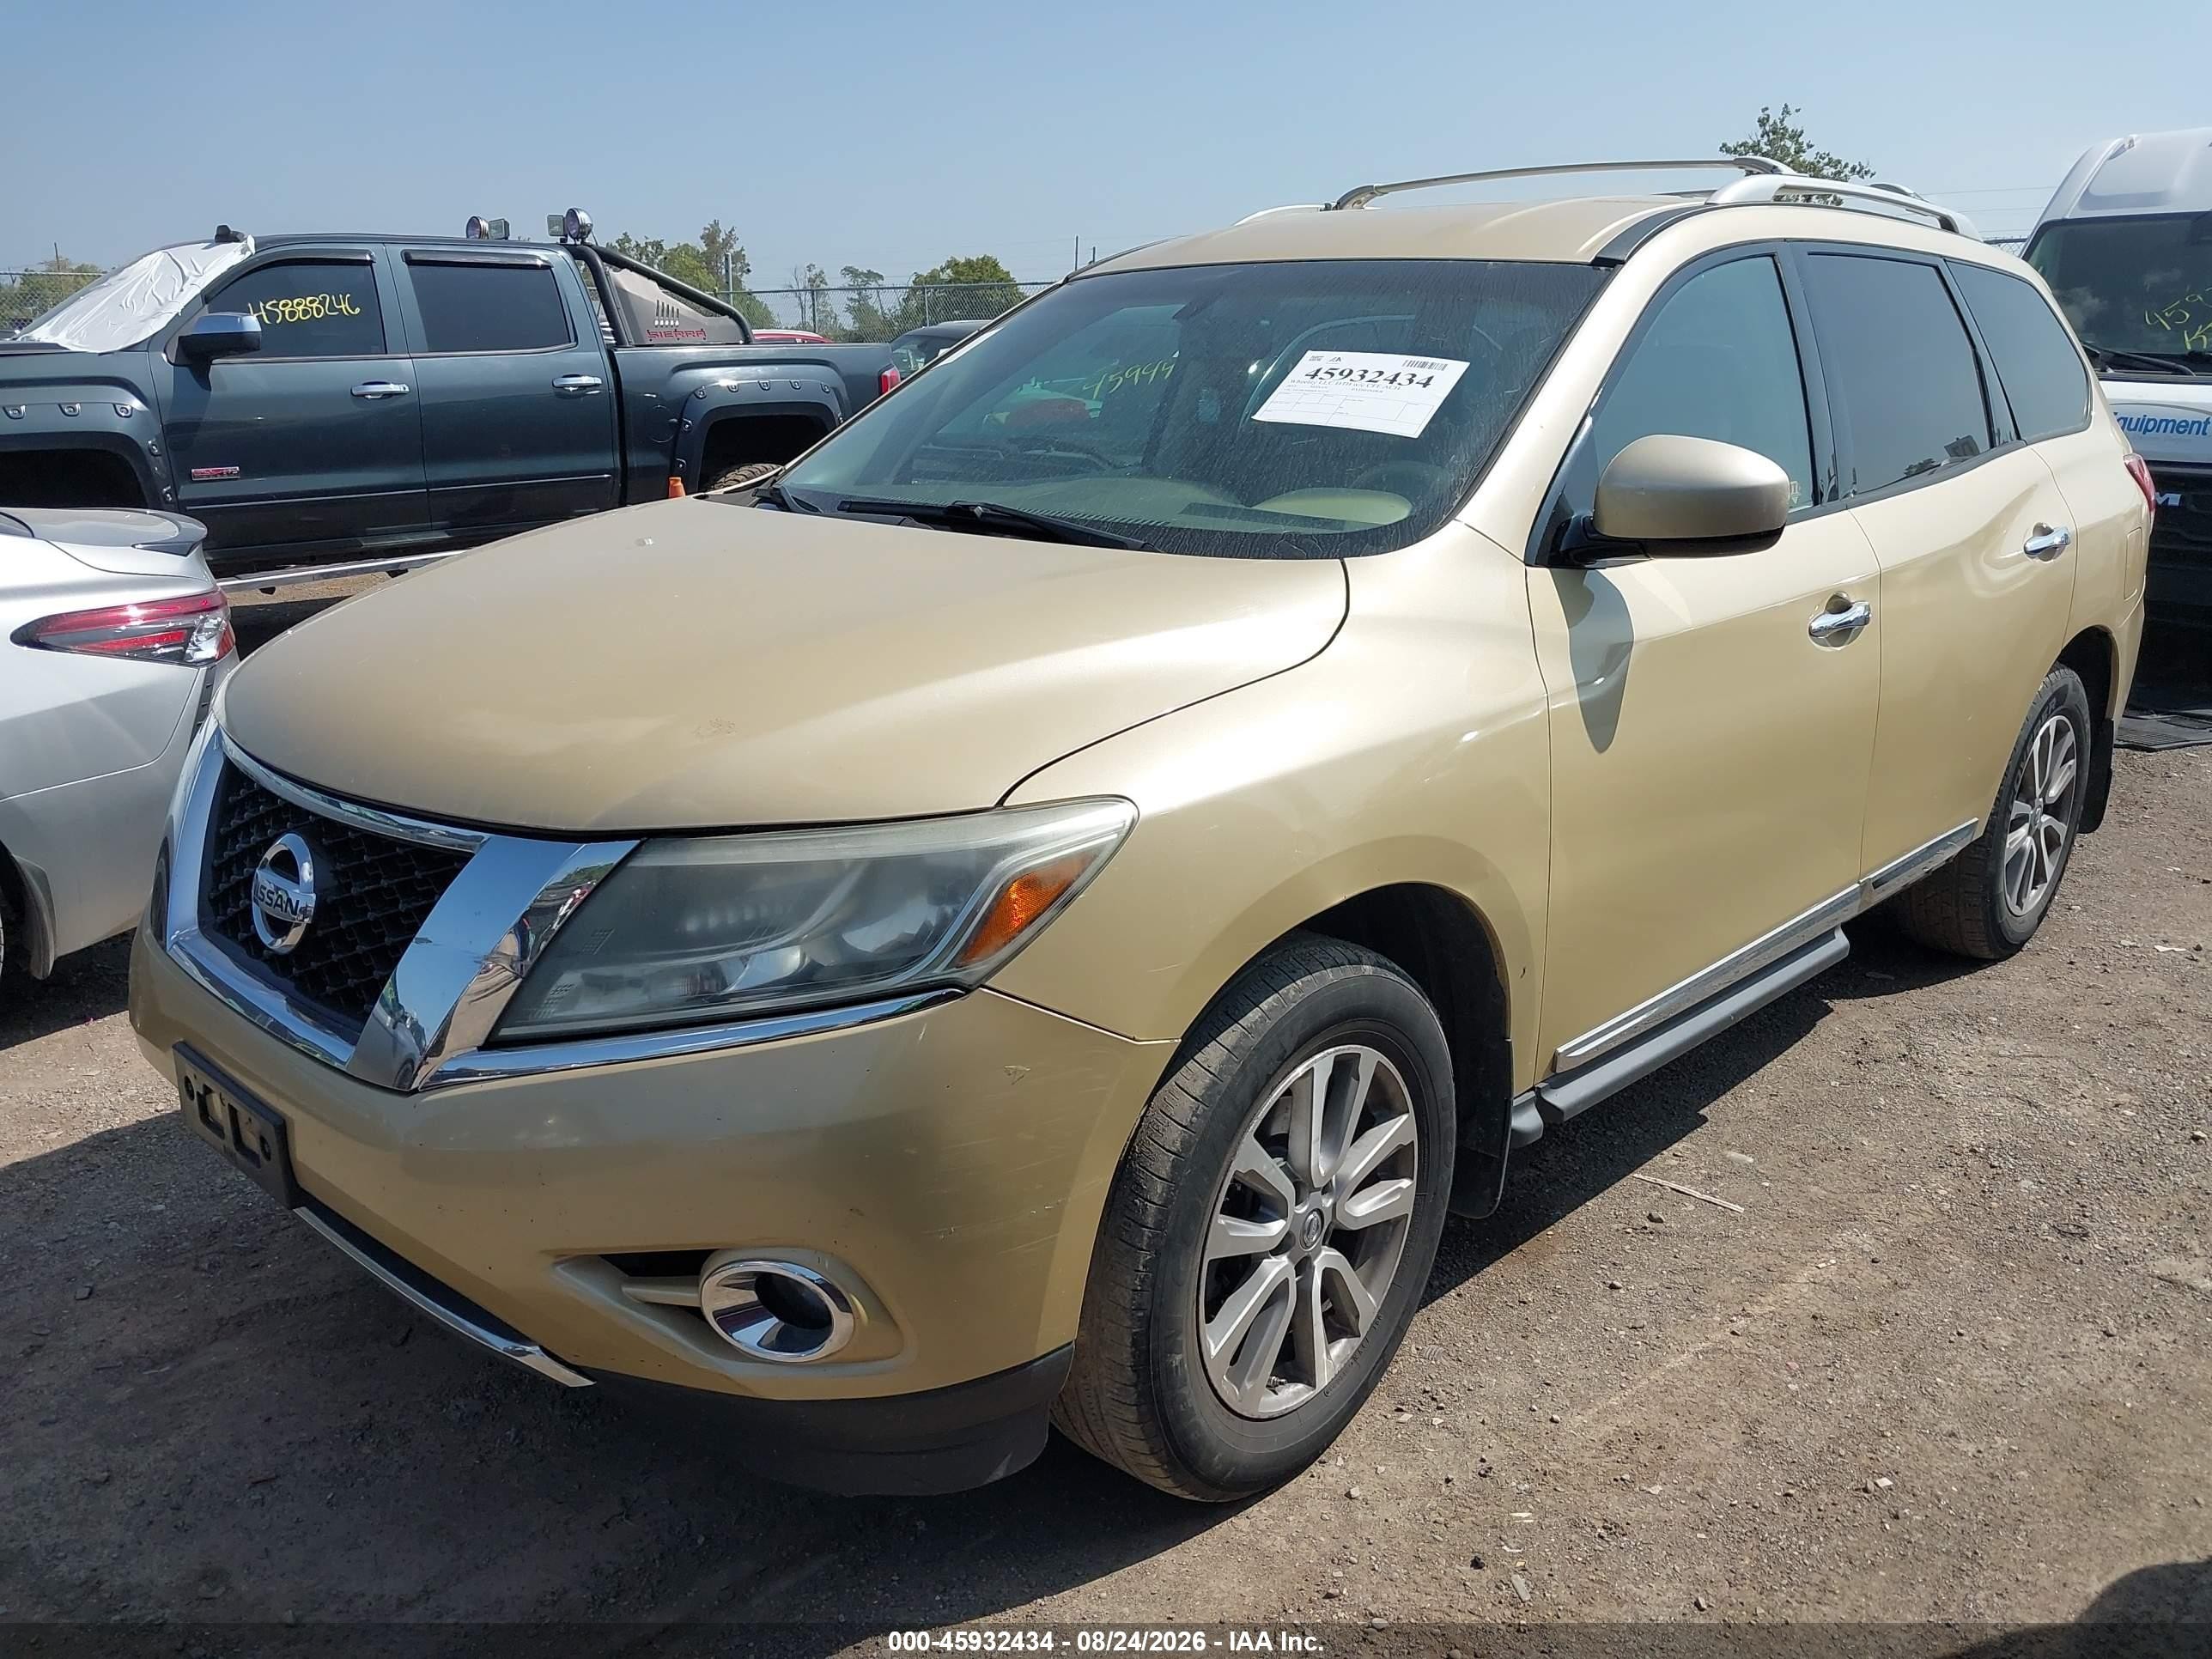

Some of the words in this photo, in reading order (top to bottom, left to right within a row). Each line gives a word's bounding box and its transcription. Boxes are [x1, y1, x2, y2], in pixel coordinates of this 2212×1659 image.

[647, 329, 707, 339] SIERRA
[1304, 368, 1435, 389] 45932434
[2113, 412, 2211, 435] quipment
